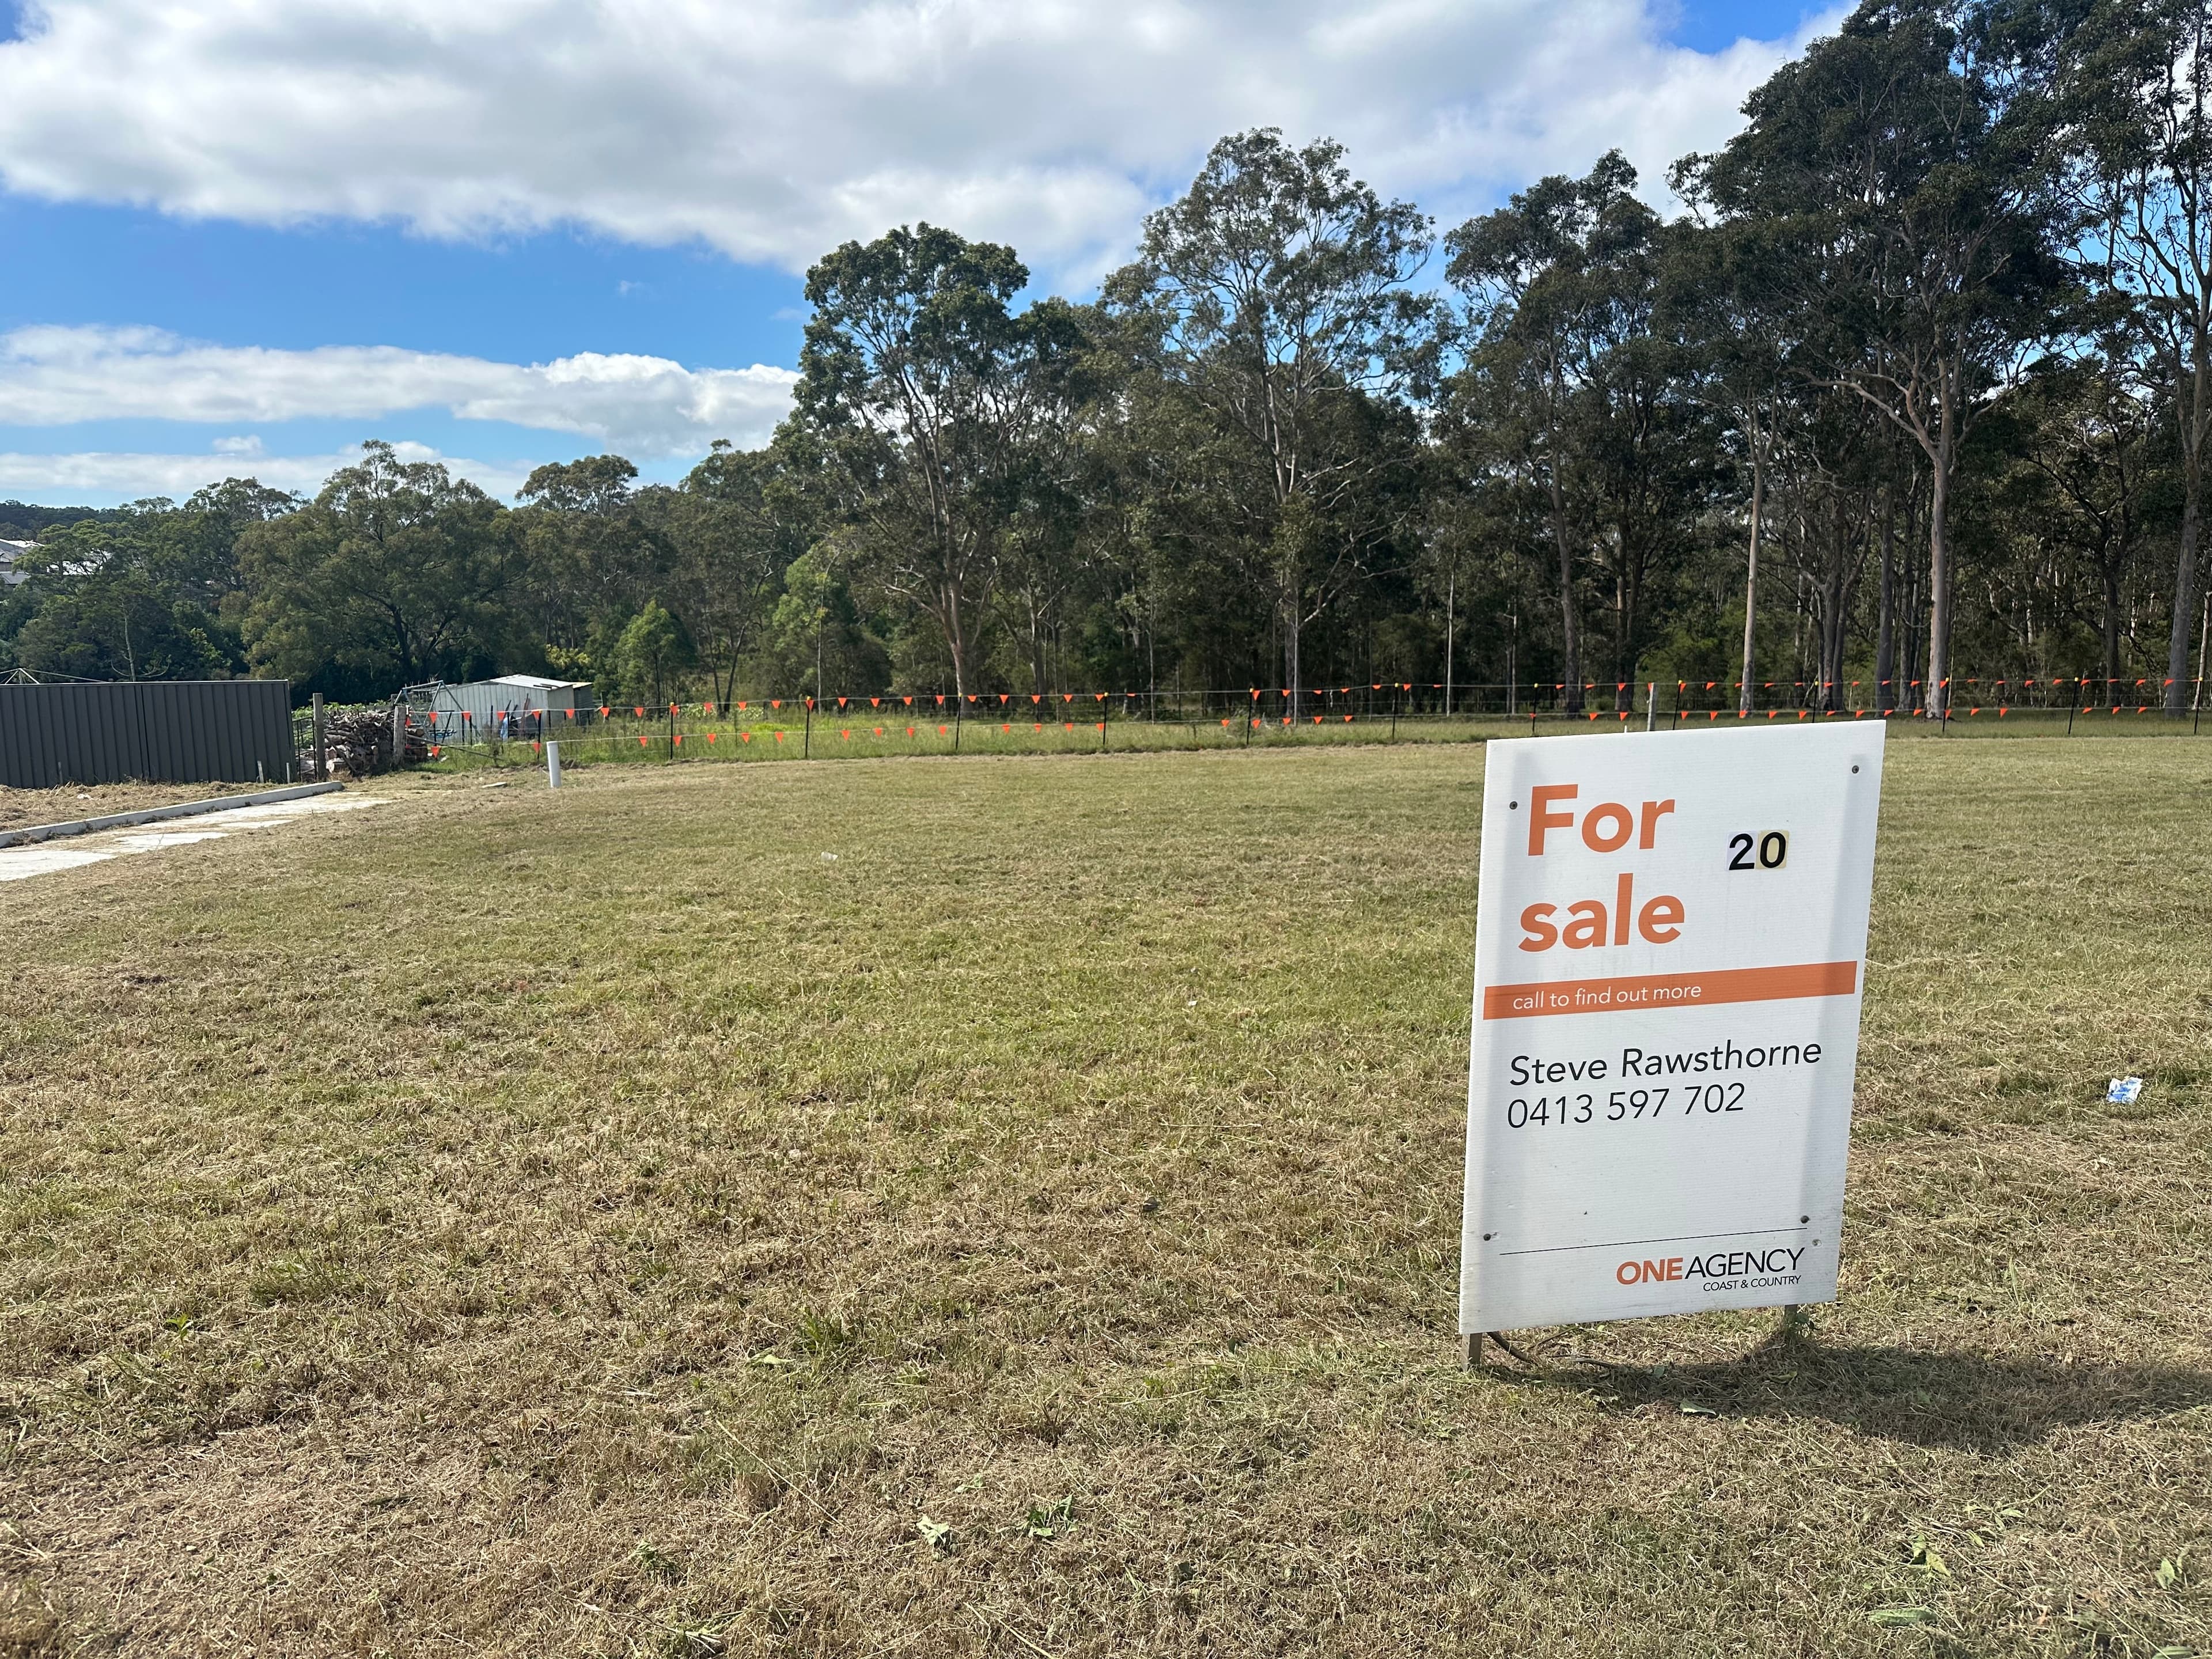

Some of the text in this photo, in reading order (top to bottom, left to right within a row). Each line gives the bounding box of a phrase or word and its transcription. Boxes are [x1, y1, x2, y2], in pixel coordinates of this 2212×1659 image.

[1529, 784, 1675, 855] For
[1729, 832, 1786, 870] 20
[1518, 873, 1685, 952] sale
[1513, 986, 1702, 1010] call to find out more
[1510, 1040, 1821, 1085] Steve Rawsthorne
[1508, 1083, 1744, 1128] 0413 597 702
[1703, 1275, 1801, 1291] COAST & COUNTRY
